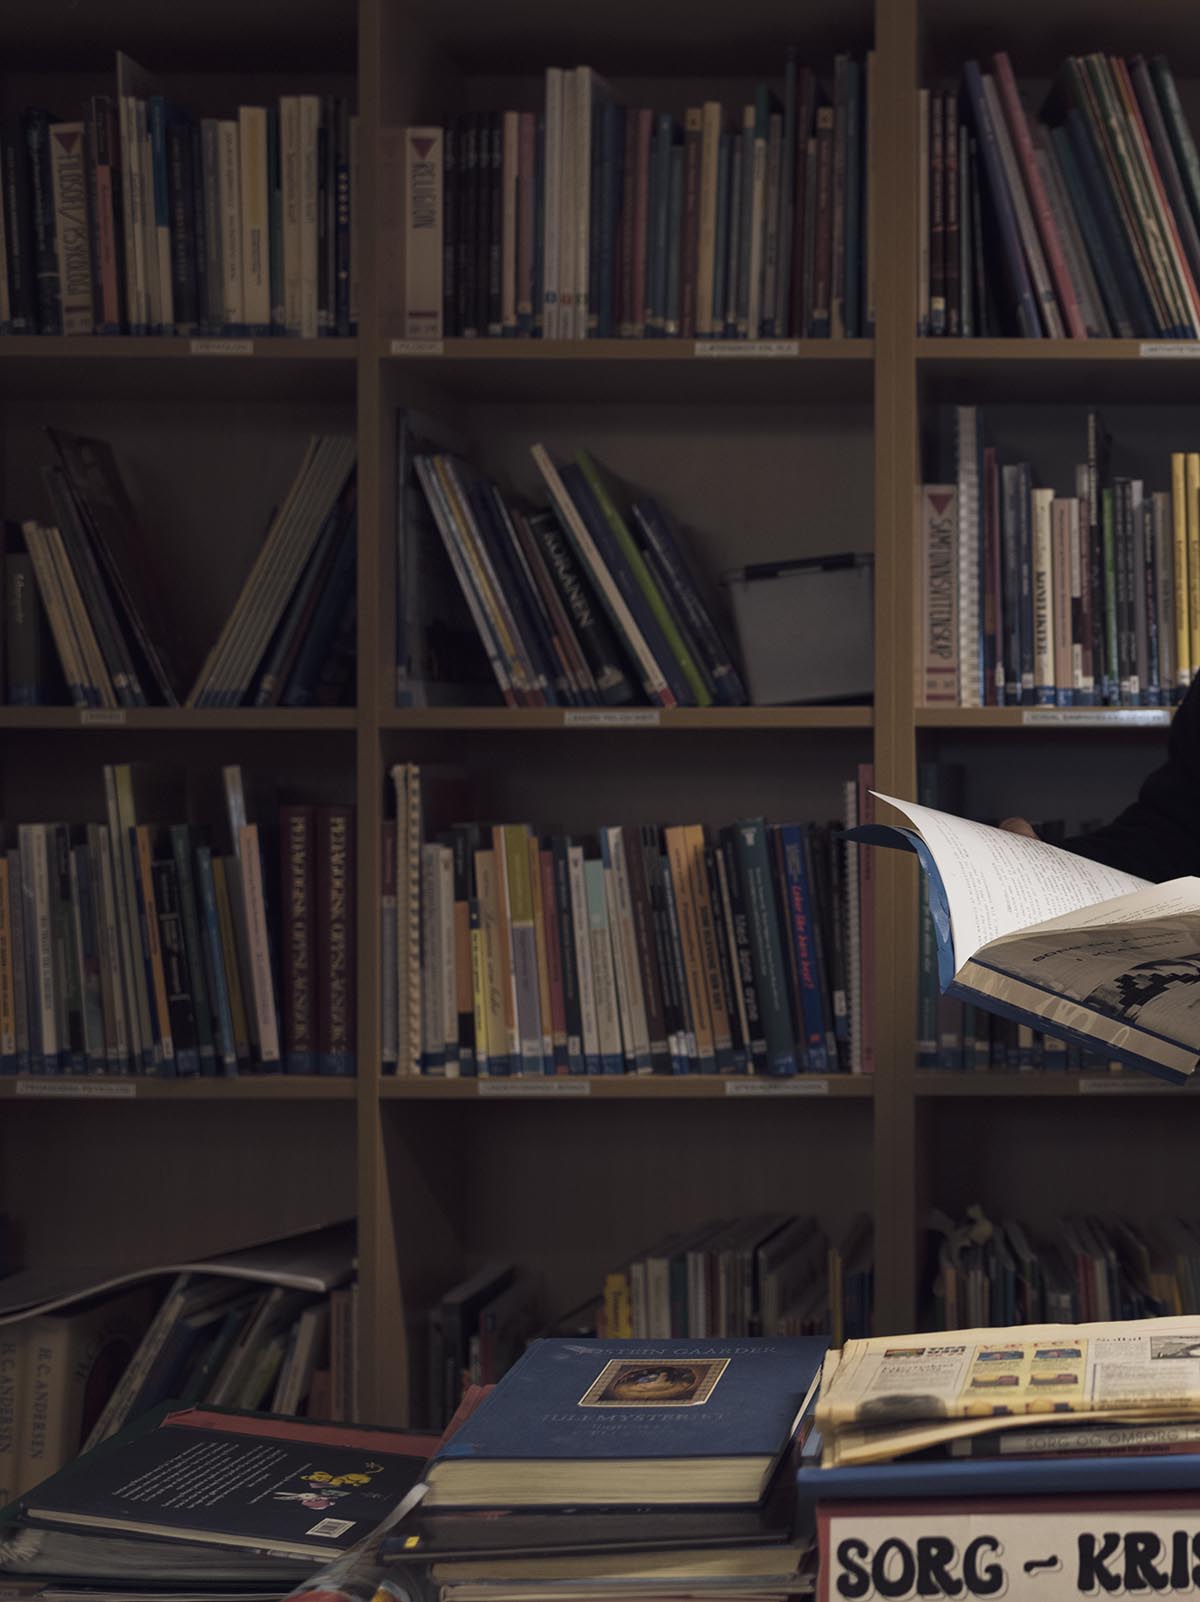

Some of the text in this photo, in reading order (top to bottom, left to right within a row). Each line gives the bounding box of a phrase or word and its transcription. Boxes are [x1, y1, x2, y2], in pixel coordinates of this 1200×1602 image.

[411, 162, 437, 229] RELIGION
[544, 532, 596, 630] KORANEN
[928, 517, 957, 660] SAMFUNNSVITENSKAP
[1036, 570, 1048, 656] KONFLIKTER
[290, 815, 309, 918] PEDAGOGISK
[329, 815, 348, 920] PEDAGOGISK
[736, 914, 758, 1022] Med åpne øyne
[673, 1346, 778, 1356] GAARDER
[31, 1382, 49, 1459] ANDERSEN
[1024, 1435, 1070, 1451] SORG
[1074, 1433, 1102, 1447] OG
[1108, 1429, 1179, 1444] OMSORG
[836, 1536, 1007, 1600] SORG
